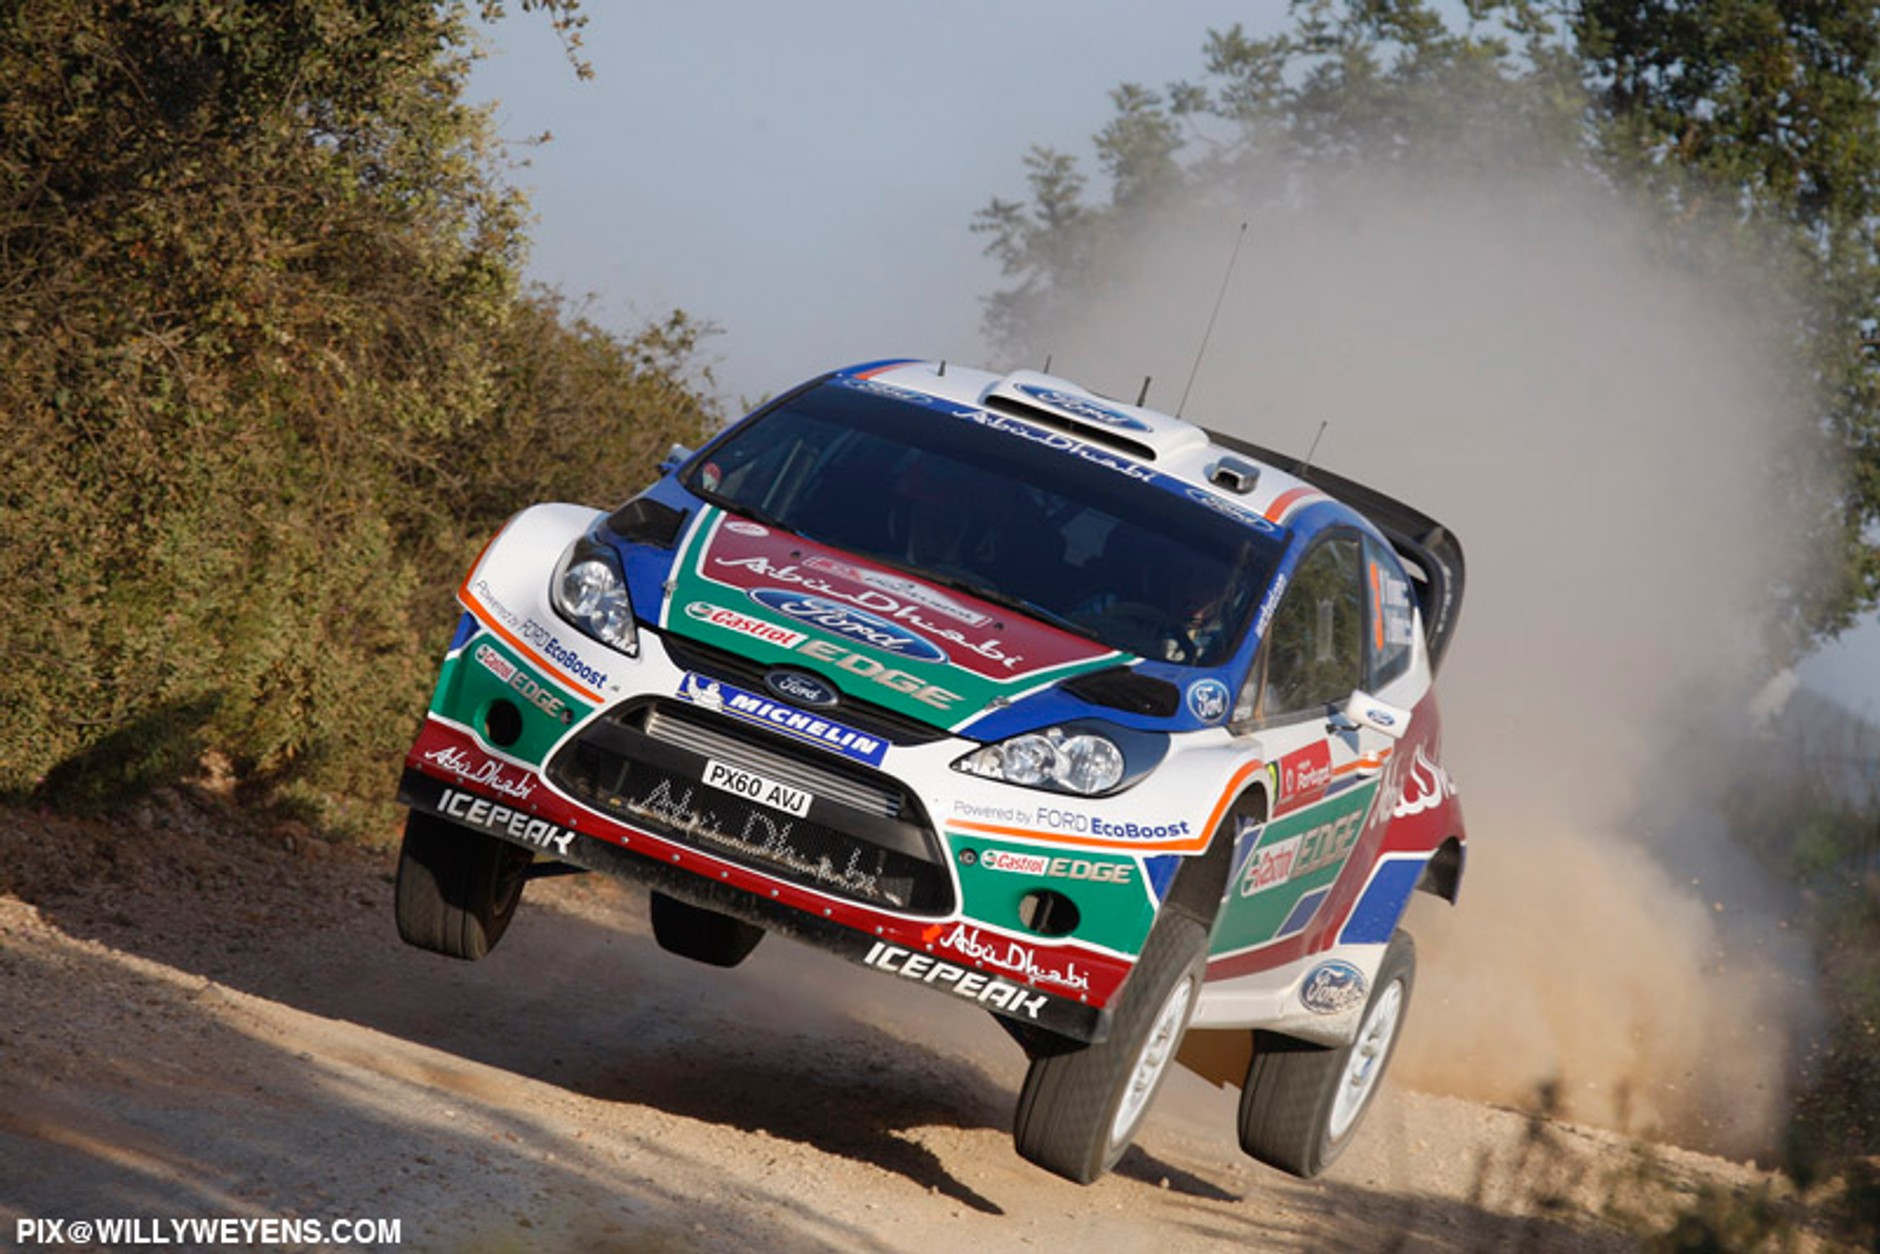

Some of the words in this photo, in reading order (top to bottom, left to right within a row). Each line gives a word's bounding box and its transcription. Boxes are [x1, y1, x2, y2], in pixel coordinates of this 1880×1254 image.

[1037, 391, 1128, 424] Ford
[953, 409, 1044, 444] Abu
[1043, 432, 1157, 484] Dhabi
[714, 555, 850, 602] Abu
[845, 590, 1024, 671] Dhabi
[778, 596, 914, 654] Ford
[545, 638, 608, 689] EcoBoost
[711, 608, 798, 647] Castrol
[798, 638, 966, 710] EDGE
[509, 671, 566, 718] EDGE
[779, 673, 822, 702] Ford
[728, 693, 880, 756] MICHELIN
[424, 746, 475, 779] Abu
[473, 760, 538, 800] Dhabi
[709, 765, 763, 798] PX60
[767, 786, 807, 813] AVJ
[436, 788, 576, 856] ICEPEAK
[953, 800, 1014, 821] Powered
[1015, 808, 1032, 826] by
[1035, 807, 1087, 833] FORD
[1091, 818, 1191, 839] EcoBoost
[997, 854, 1045, 874] Castrol
[1049, 857, 1135, 885] EDGE
[863, 941, 1049, 1020] ICEPEAK
[940, 925, 1007, 966] Abu
[1005, 943, 1090, 991] Dhabi
